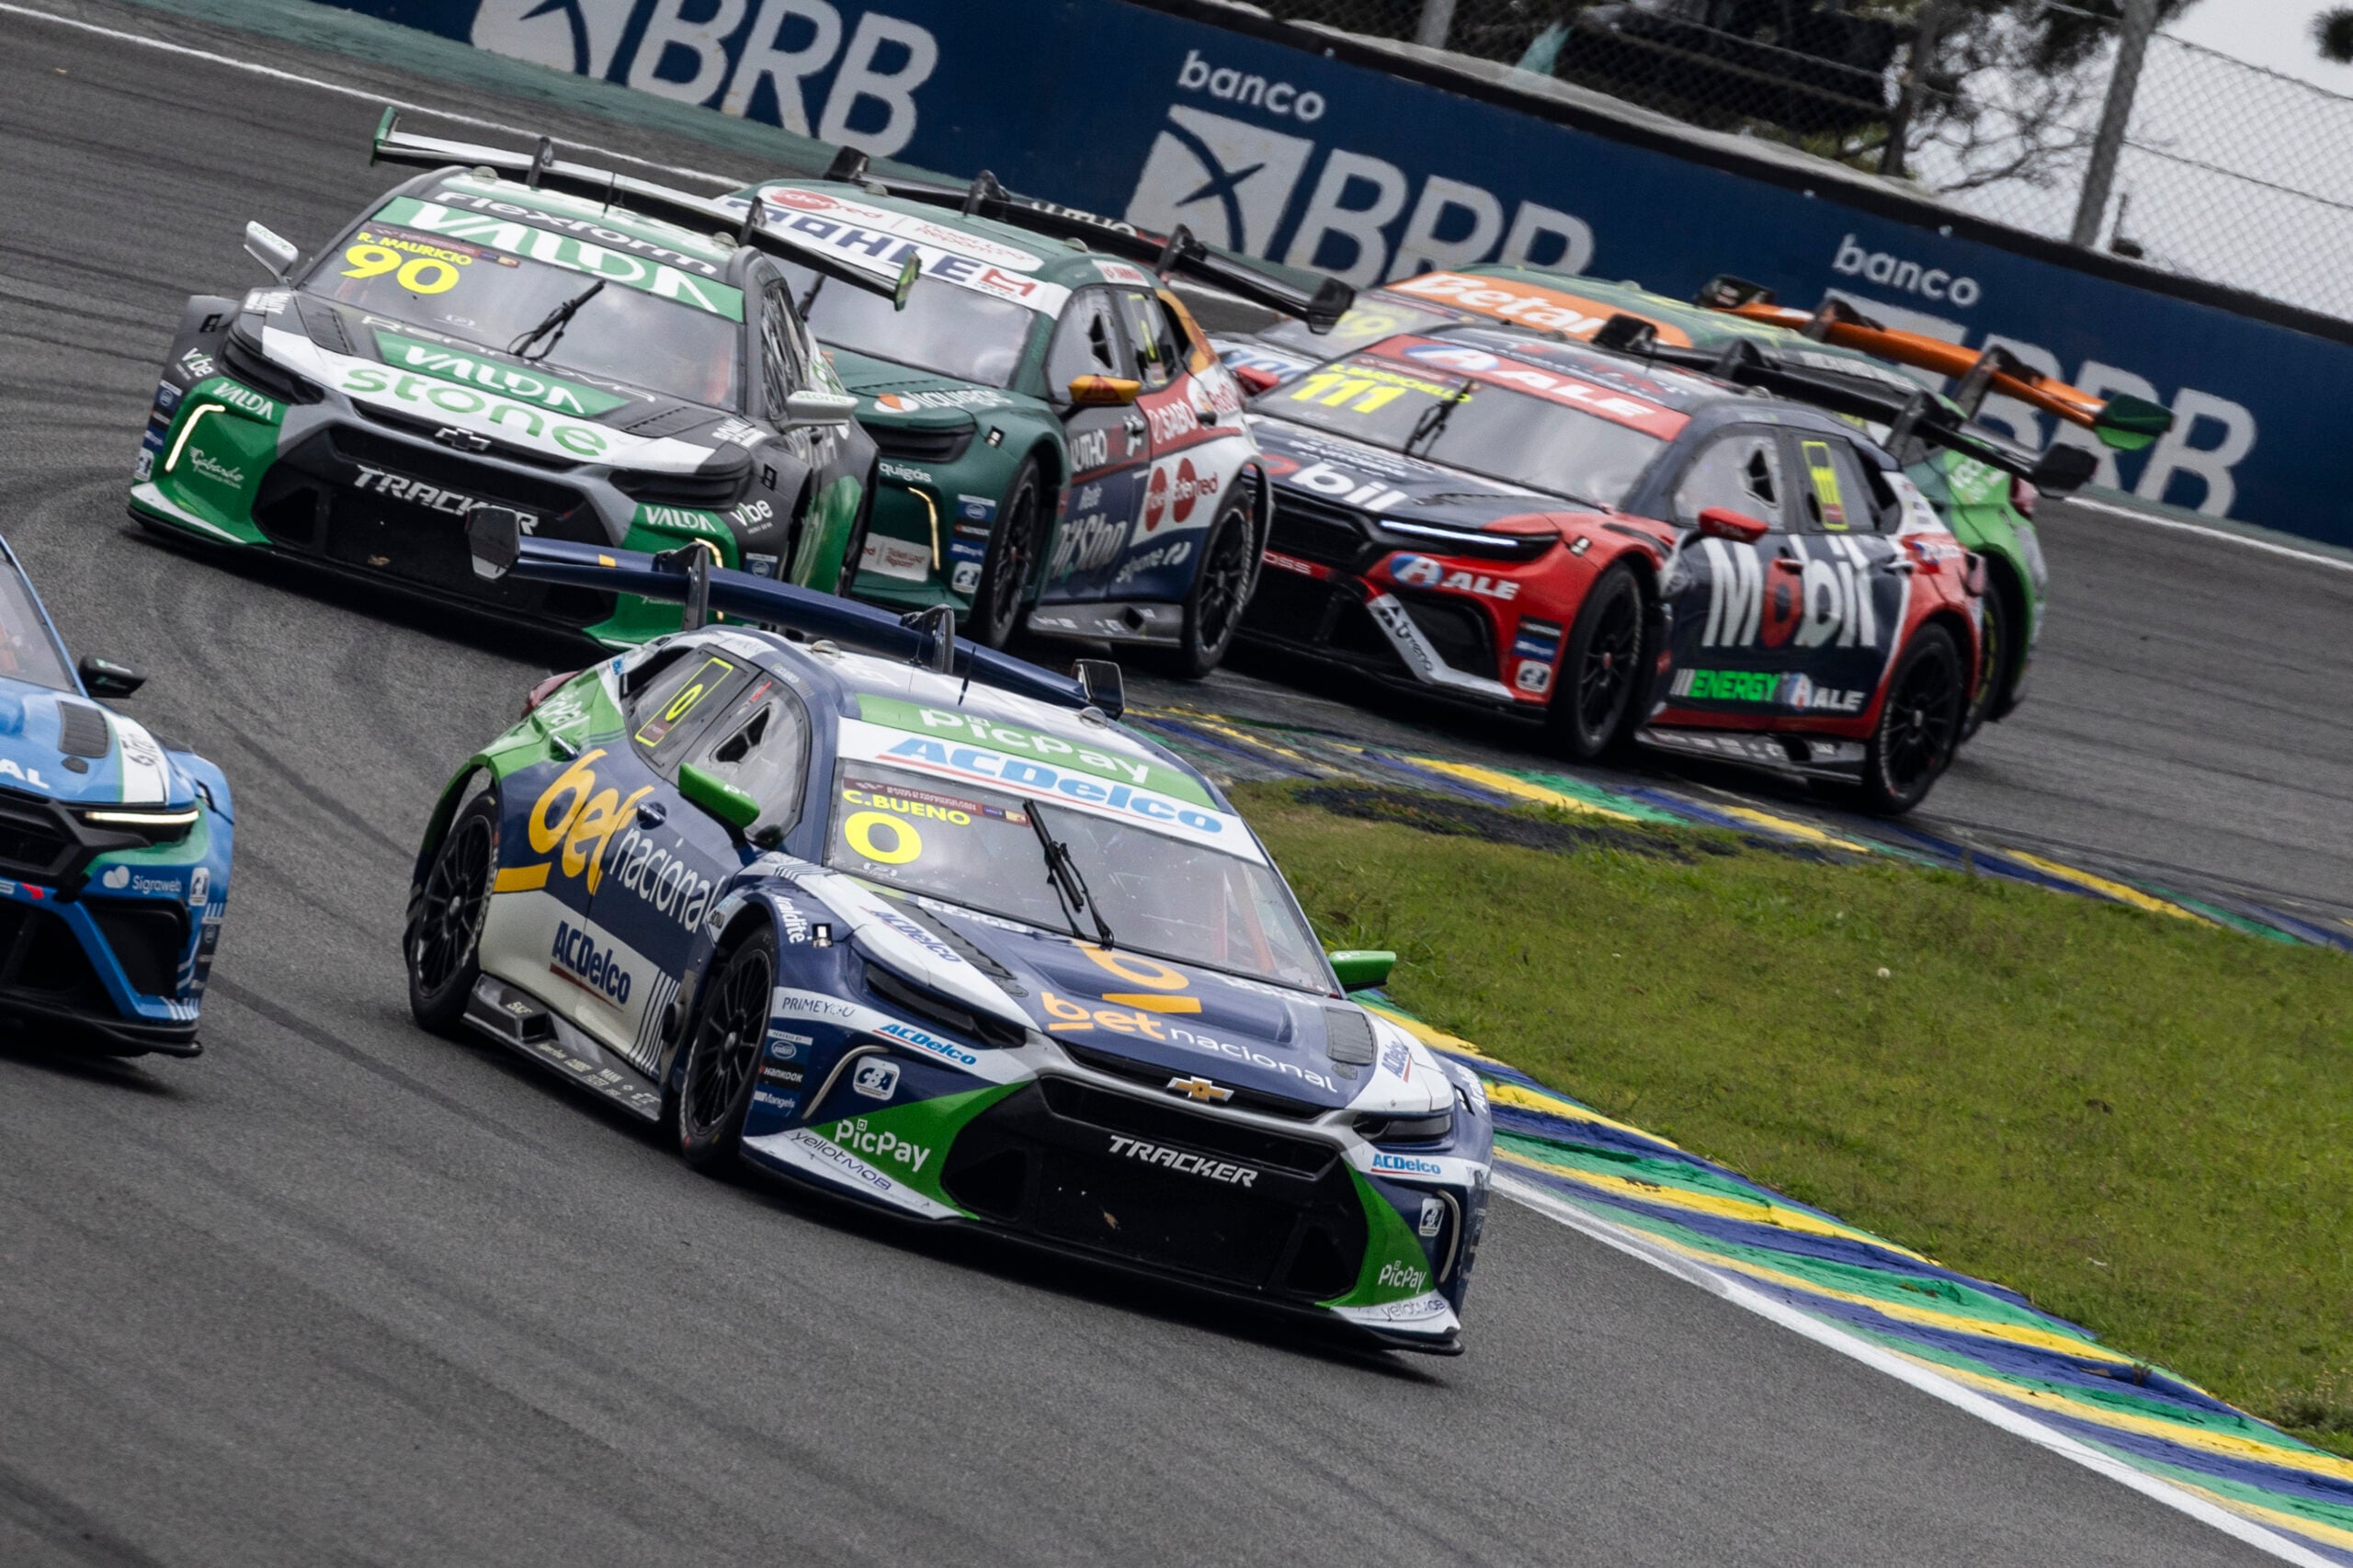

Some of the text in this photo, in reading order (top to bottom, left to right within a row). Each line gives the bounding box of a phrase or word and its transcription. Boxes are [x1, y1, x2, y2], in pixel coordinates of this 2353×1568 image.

[629, 0, 939, 159] BRB
[1177, 50, 1326, 122] banco
[379, 236, 472, 266] MAURICIO
[434, 190, 717, 275] Flexform
[339, 244, 460, 295] 90
[1832, 233, 1982, 308] banco
[1392, 272, 1604, 335] Betan
[342, 368, 608, 457] stone
[1290, 372, 1408, 415] 111
[1490, 369, 1657, 417] ALE
[879, 461, 933, 483] quigás
[354, 464, 540, 536] TRACKR
[1442, 572, 1520, 601] ALE
[1701, 534, 1877, 647] Mobil
[1688, 669, 1780, 701] ENERGY
[1812, 687, 1867, 712] ALE
[842, 789, 972, 826] C.BUENO
[888, 737, 1223, 834] ACDelco
[528, 747, 728, 935] bet nacional
[844, 810, 923, 865] 0
[131, 874, 182, 895] Sigraweb
[551, 920, 632, 1005] ACDelco
[870, 910, 962, 963] ACDelco
[880, 1023, 978, 1066] ACDelco
[1040, 992, 1338, 1094] bet nacional
[856, 1065, 897, 1091] CBA
[833, 1118, 932, 1173] PicPay
[1108, 1134, 1259, 1187] TRACKER
[1371, 1153, 1442, 1176] ACDelco
[1378, 1260, 1427, 1295] PicPay
